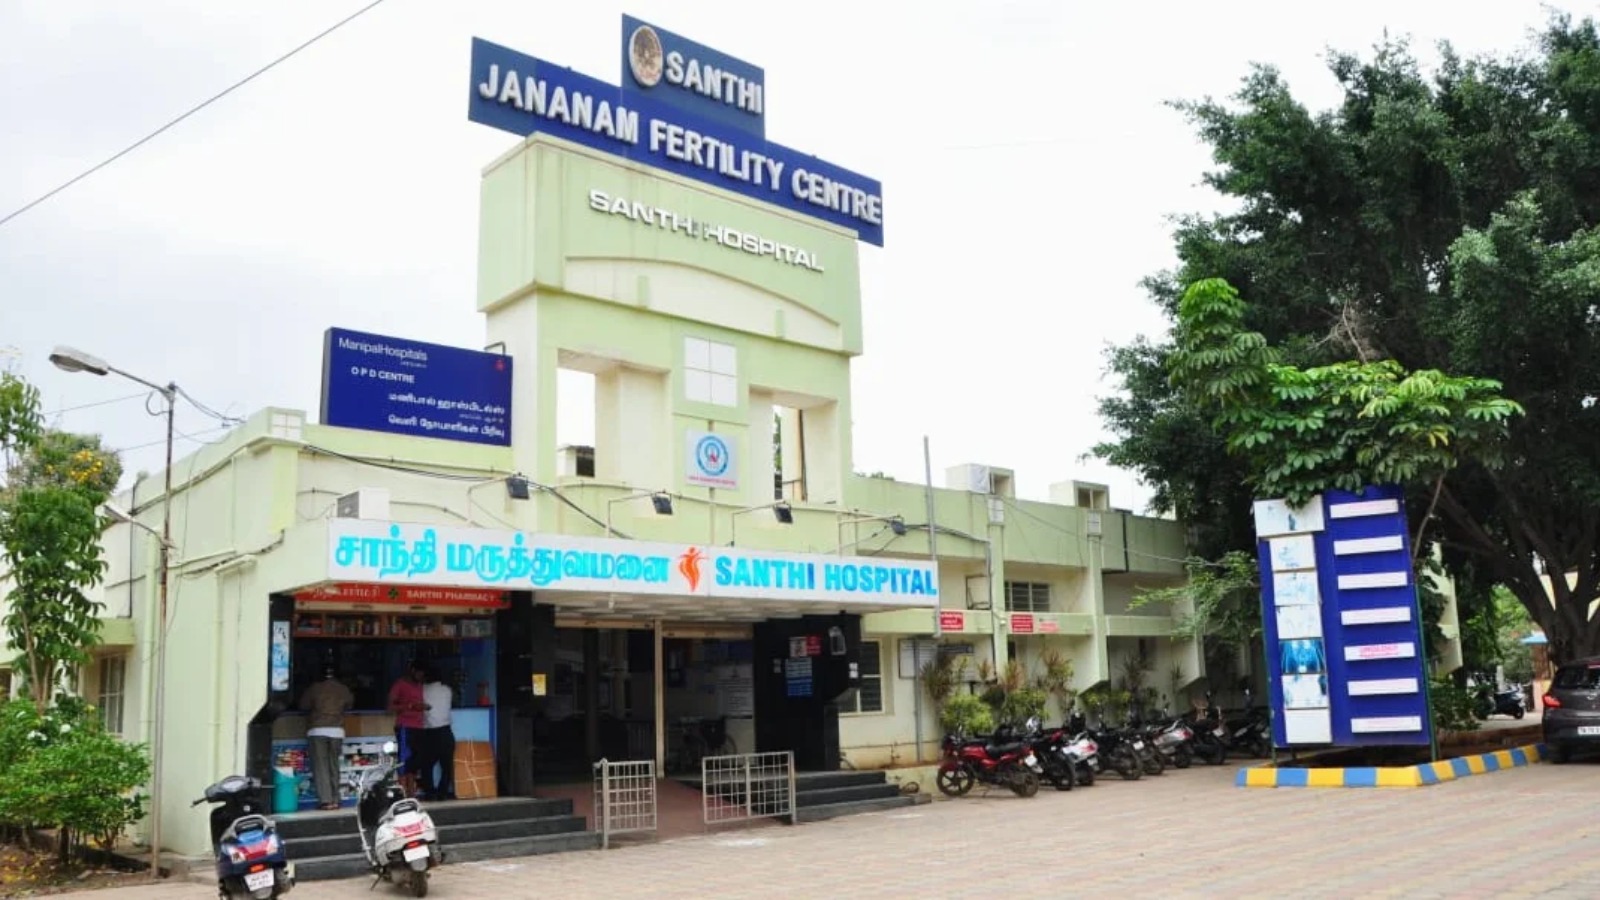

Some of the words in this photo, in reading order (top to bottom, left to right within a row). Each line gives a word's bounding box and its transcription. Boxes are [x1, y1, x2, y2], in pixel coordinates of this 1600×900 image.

[666, 51, 762, 114] SANTHI
[479, 64, 639, 144] JANANAM
[650, 119, 784, 190] FERTILITY
[792, 168, 882, 224] CENTRE
[703, 222, 825, 273] HOSPITAL
[378, 371, 415, 384] CENTRE
[335, 524, 437, 578] சாந்தி
[446, 532, 670, 587] மருத்துவமனை
[715, 556, 815, 590] SANTHI
[824, 563, 937, 595] HOSPITAL
